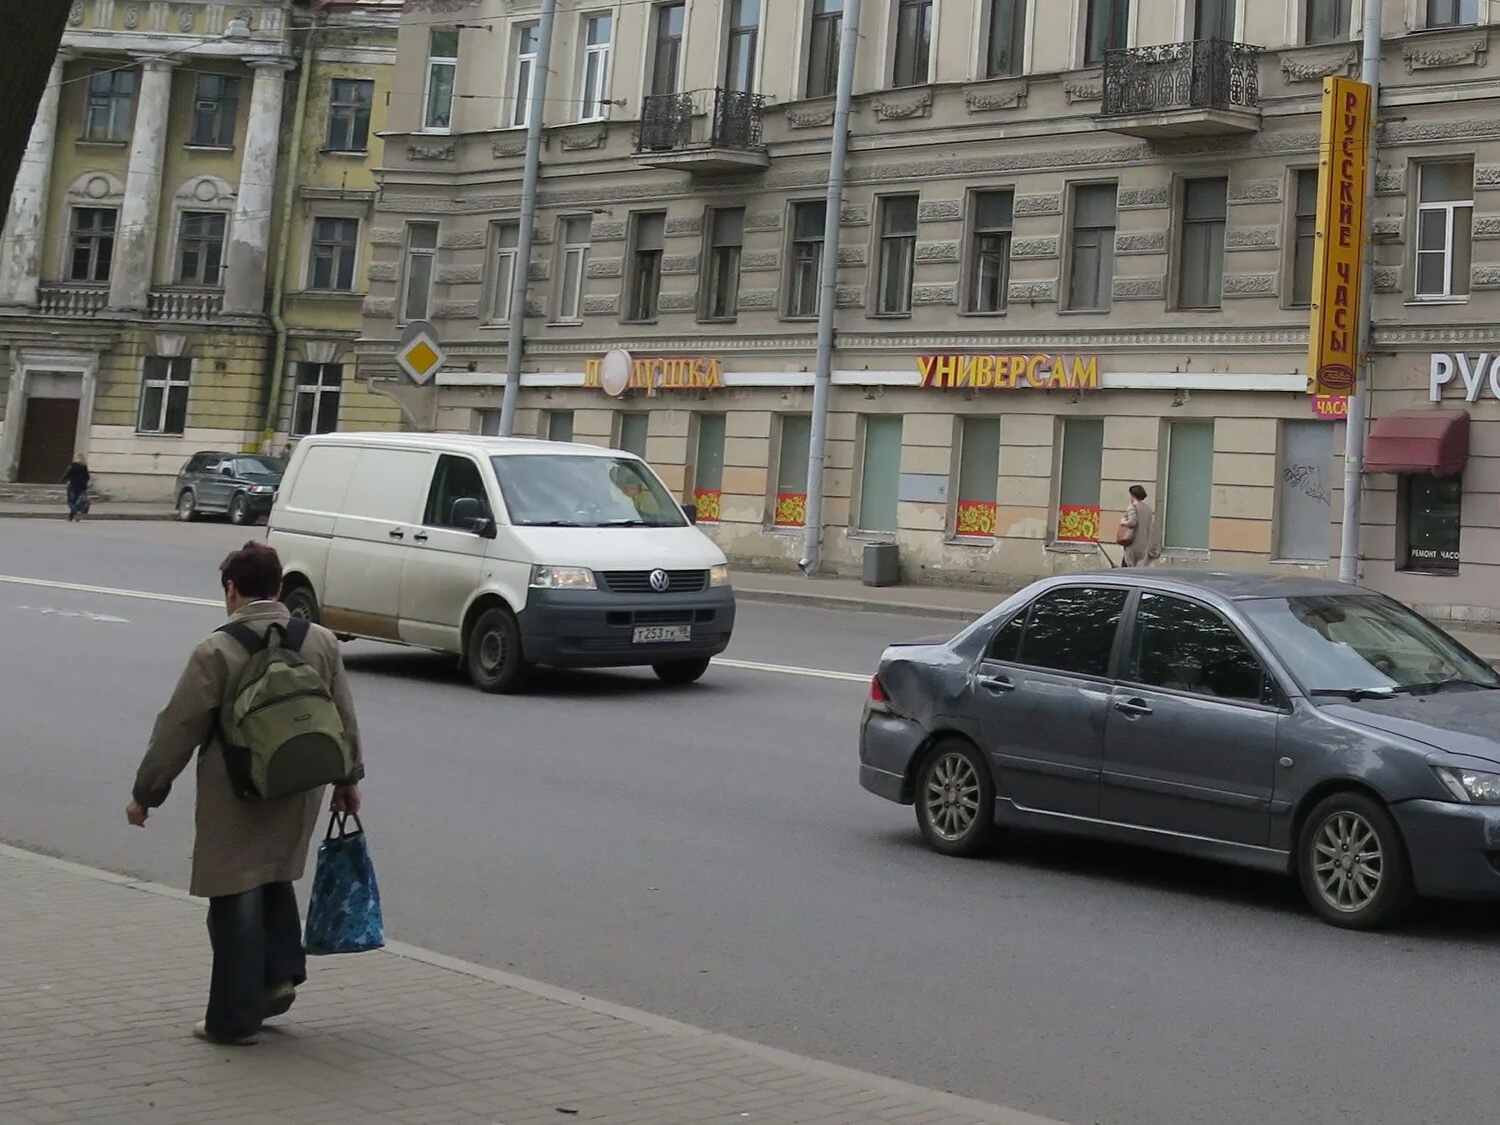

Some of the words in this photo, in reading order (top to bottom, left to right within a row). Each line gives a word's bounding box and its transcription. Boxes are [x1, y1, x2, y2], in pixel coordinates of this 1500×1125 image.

[1338, 91, 1358, 249] РУССКИЕ
[1329, 261, 1351, 355] ЧАСЫ
[916, 354, 1101, 389] УНИВЕРСАМ
[1411, 549, 1437, 558] РЕМОНТ
[1440, 551, 1459, 560] ЧАСО
